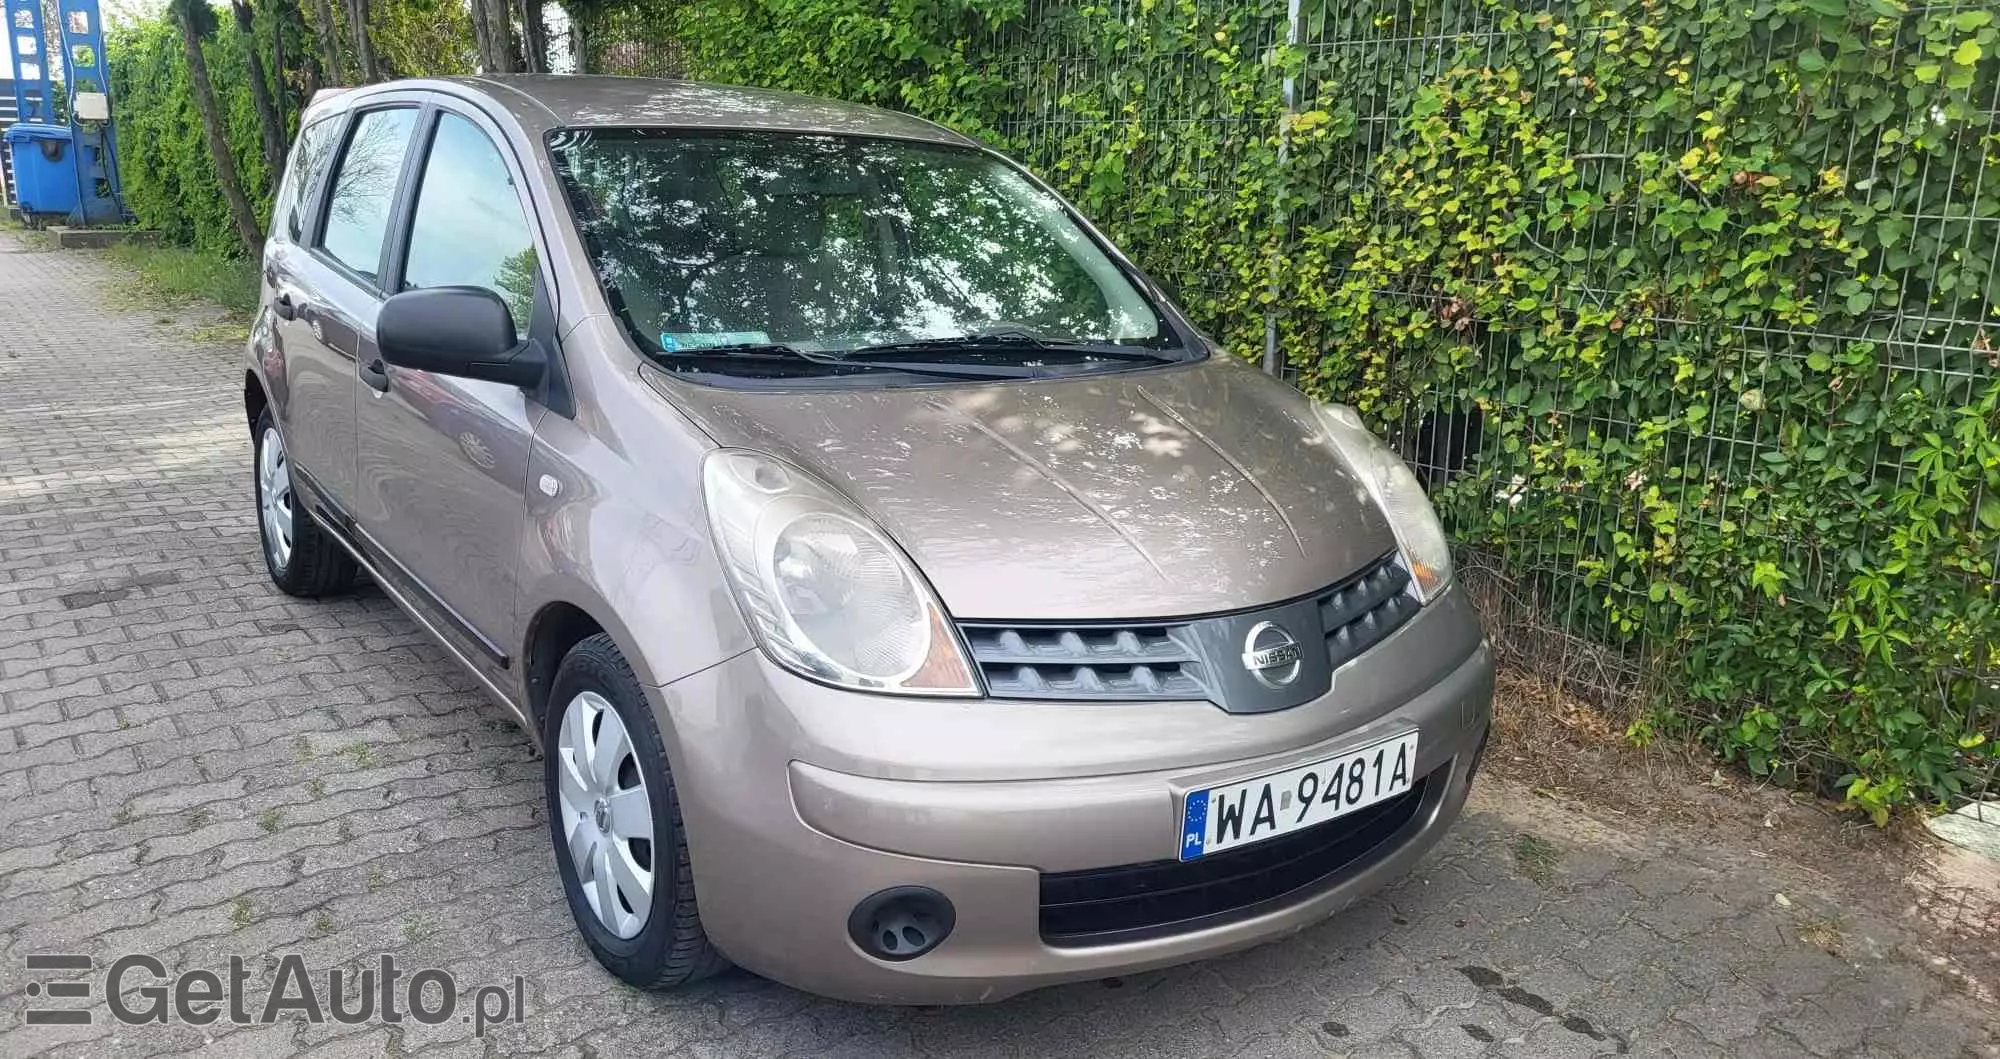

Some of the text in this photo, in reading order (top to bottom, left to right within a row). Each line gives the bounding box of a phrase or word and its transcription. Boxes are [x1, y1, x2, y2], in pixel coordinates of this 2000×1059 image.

[1253, 645, 1301, 666] NISSAN
[1217, 742, 1409, 844] WA 9481A
[1185, 835, 1202, 848] PL
